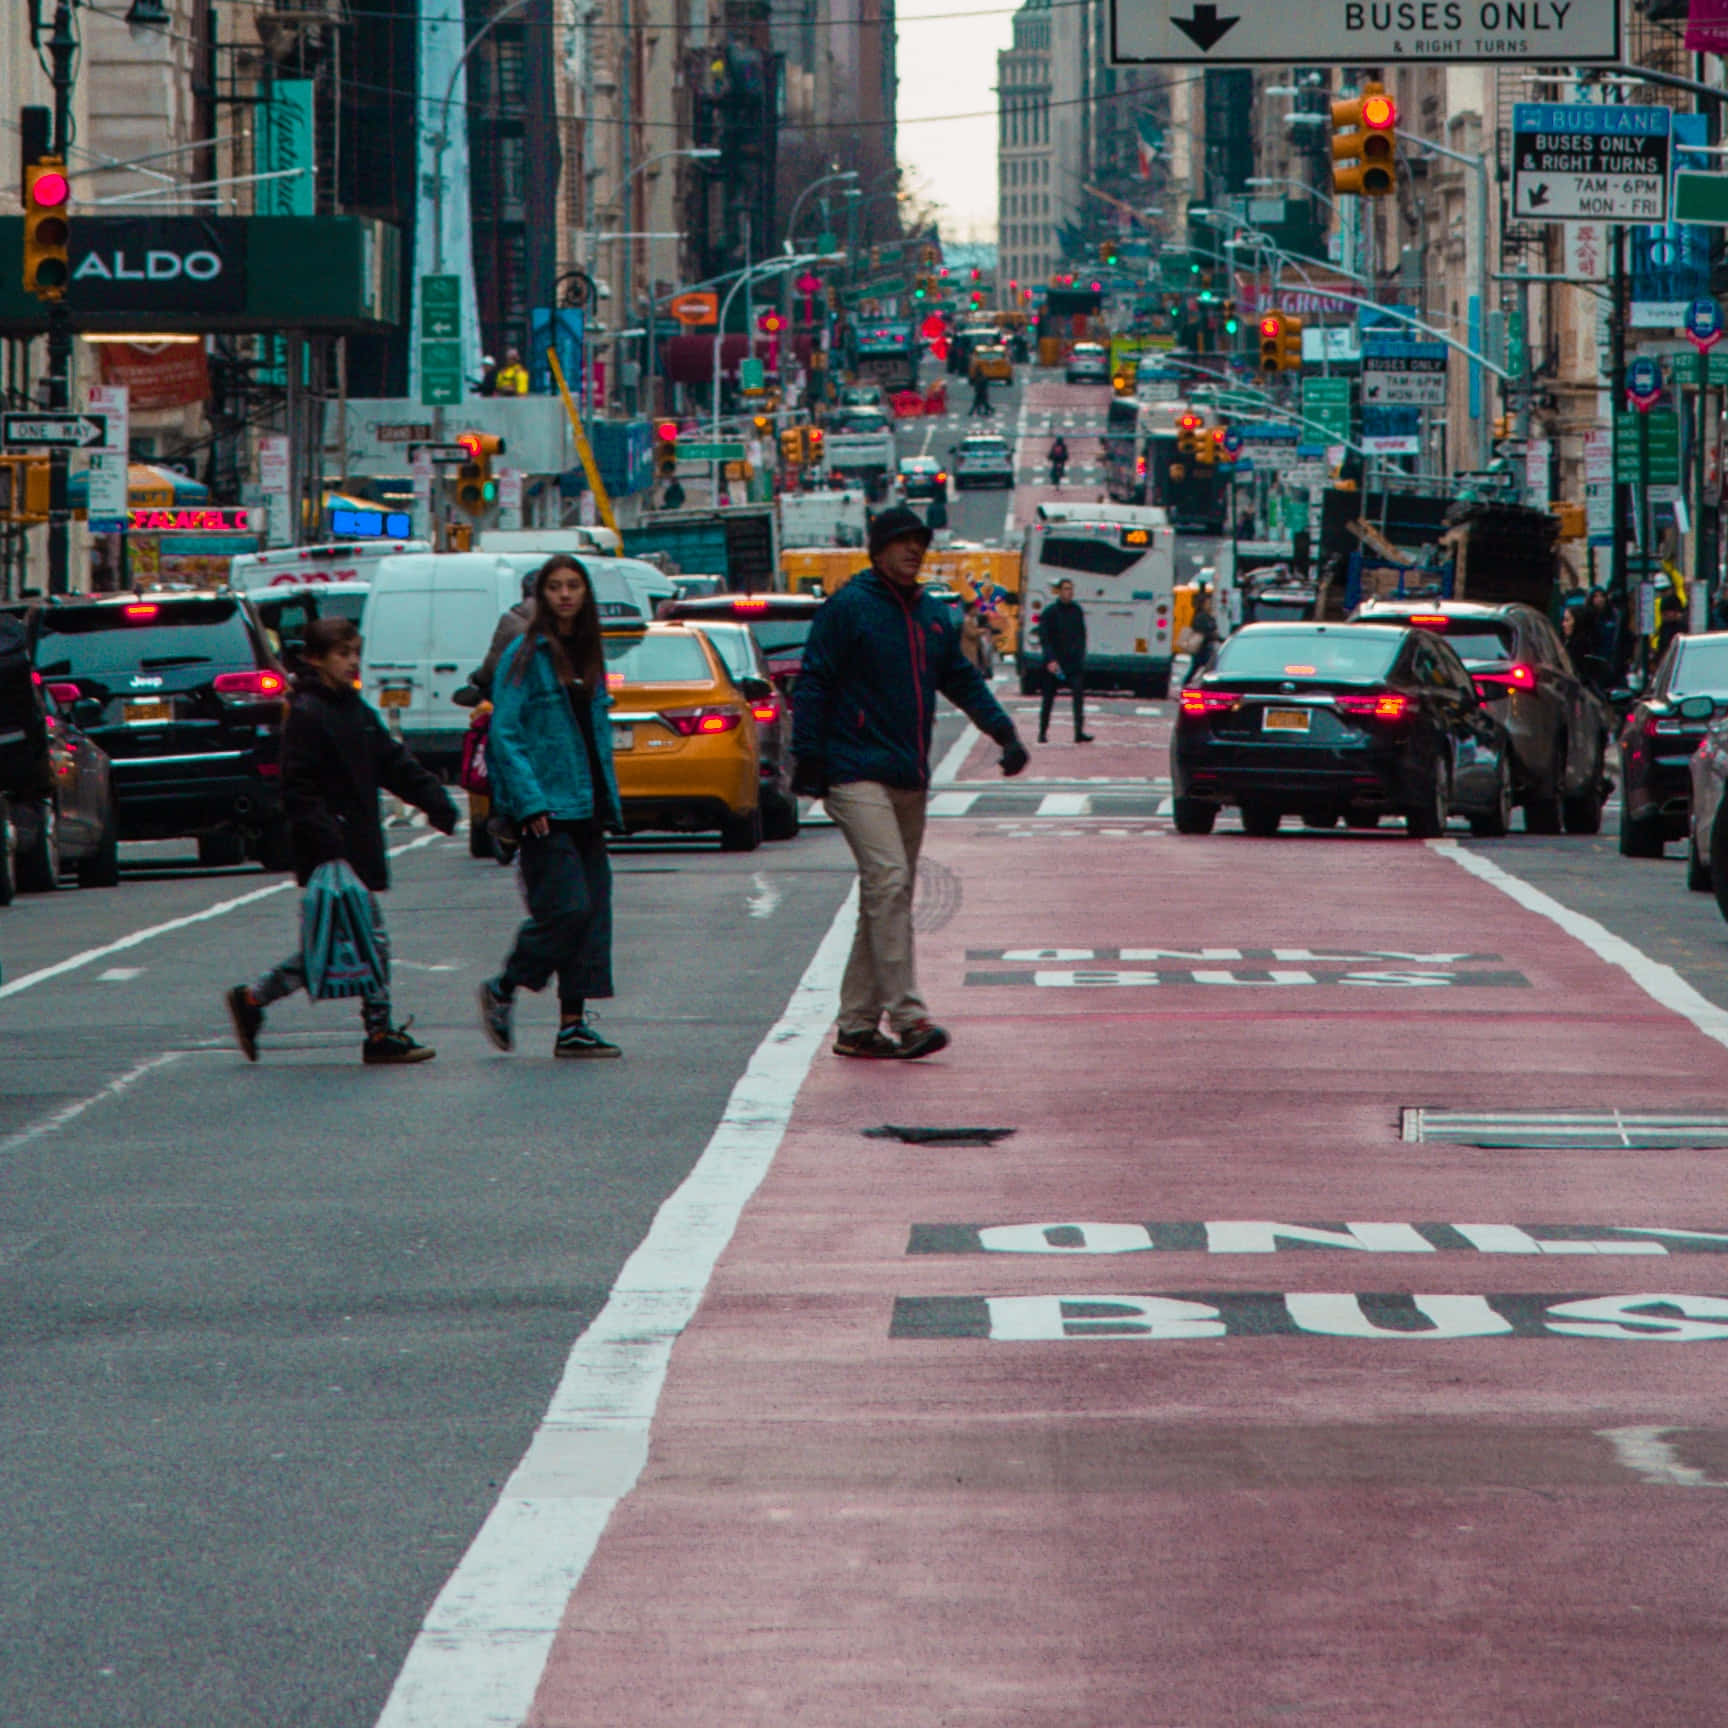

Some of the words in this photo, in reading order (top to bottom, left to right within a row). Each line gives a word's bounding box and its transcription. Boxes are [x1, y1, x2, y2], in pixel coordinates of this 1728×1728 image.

[1345, 3, 1463, 31] BUSES
[1480, 2, 1572, 30] ONLY
[1393, 40, 1404, 54] &
[1414, 39, 1463, 54] RIGHT
[1475, 40, 1529, 53] TURNS
[1551, 110, 1591, 130] BUS
[1599, 111, 1660, 131] LANE
[1534, 134, 1595, 152] BUSES
[1599, 136, 1646, 152] ONLY
[1523, 155, 1536, 170] &
[1541, 154, 1593, 171] RIGHT
[1598, 156, 1658, 174] TURNS
[1574, 176, 1607, 193] 7AM
[1622, 178, 1658, 195] 6PM
[1579, 198, 1615, 214] MON
[1632, 199, 1658, 215] FRI
[72, 250, 224, 281] ALDO
[1366, 359, 1407, 371] BUSES
[1410, 359, 1441, 371] ONLY
[1387, 388, 1412, 400] MON
[18, 423, 49, 438] ONE
[62, 423, 91, 438] WAY
[128, 675, 163, 688] Jeep
[999, 947, 1473, 964] ONLY
[1033, 969, 1459, 988] BUS
